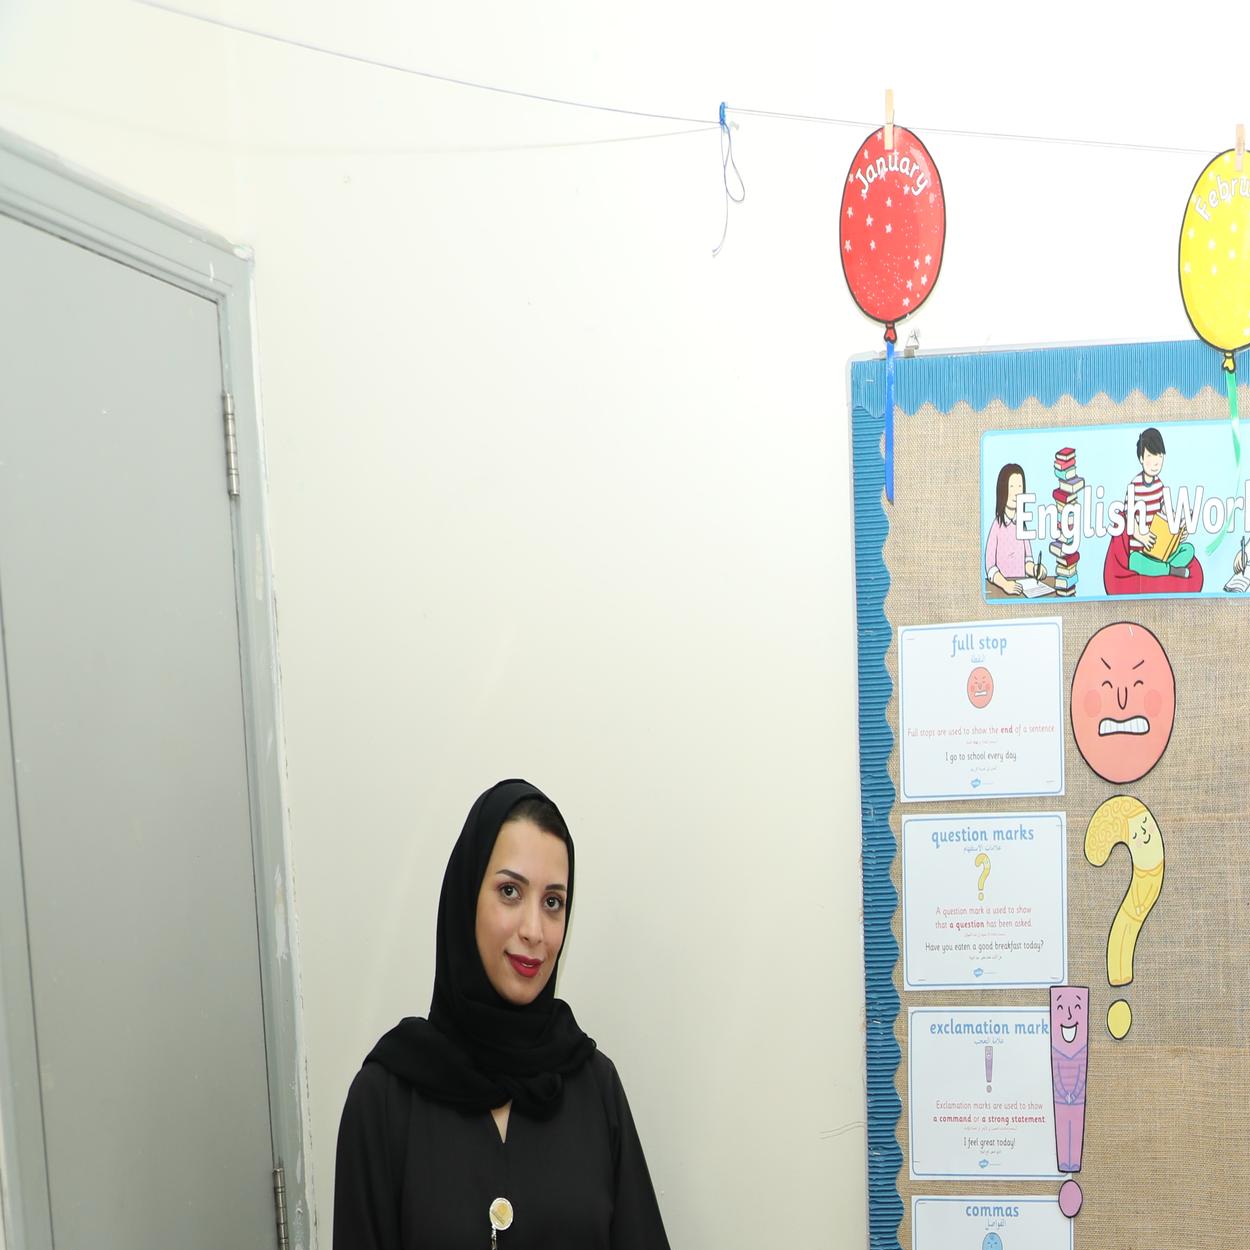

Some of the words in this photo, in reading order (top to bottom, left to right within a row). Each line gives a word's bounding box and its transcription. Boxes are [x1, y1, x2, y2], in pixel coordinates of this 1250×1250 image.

[856, 149, 929, 198] January
[1015, 478, 1151, 555] English
[950, 633, 975, 658] full
[978, 635, 1007, 656] stop
[1001, 725, 1013, 733] end
[950, 753, 957, 764] go
[968, 752, 985, 760] school
[988, 753, 1003, 762] every
[932, 827, 988, 849] question
[993, 824, 1034, 840] marks
[936, 907, 940, 915] A
[956, 920, 984, 931] question
[925, 942, 940, 951] Have
[942, 945, 953, 954] you
[955, 943, 970, 951] eaten
[978, 942, 993, 953] good
[995, 941, 1021, 952] breakfast
[1024, 940, 1044, 952] today?
[930, 1018, 1009, 1034] exclamation
[1015, 1018, 1049, 1034] mark
[936, 1100, 971, 1110] Exclamation
[974, 1100, 990, 1109] marks
[940, 1114, 971, 1123] command
[988, 1116, 1009, 1125] strong
[968, 1138, 978, 1149] feel
[980, 1140, 995, 1149] great
[997, 1138, 1015, 1149] today!
[965, 1206, 1019, 1217] commas
